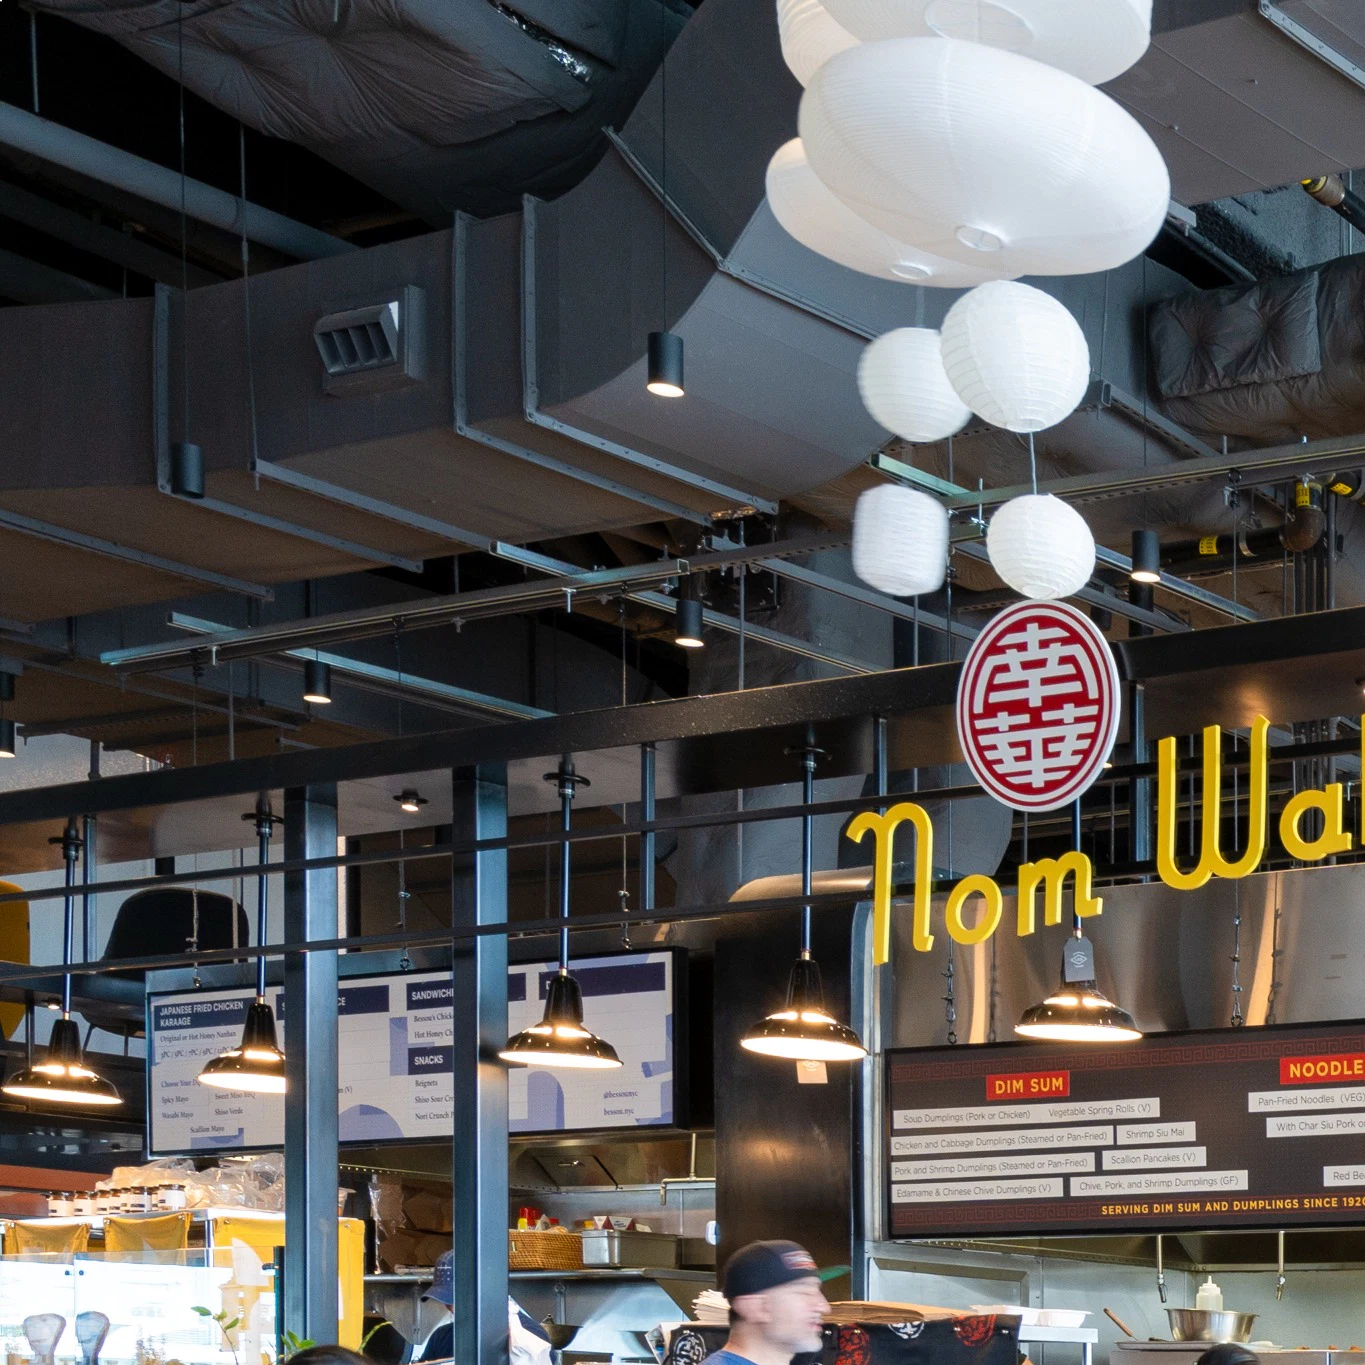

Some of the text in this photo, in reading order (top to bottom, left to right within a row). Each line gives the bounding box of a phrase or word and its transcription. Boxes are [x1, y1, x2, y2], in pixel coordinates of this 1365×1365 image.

[846, 802, 1103, 966] Nom
[160, 1001, 243, 1015] JAPANESE FRIED CHICKEN
[160, 1017, 191, 1026] KARAAGE
[415, 1055, 443, 1065] SNACKS
[995, 1077, 1063, 1094] DIM SUM
[1258, 1093, 1365, 1106] Pan-Fried Noodles (VEG)
[1048, 1103, 1151, 1117] Vegetable Spring Rolls (V)
[904, 1115, 922, 1125] Soup
[925, 1113, 963, 1124] Dumplings
[966, 1112, 986, 1122] (Pork
[998, 1110, 1031, 1120] Chicken)
[1277, 1122, 1296, 1131] With
[1299, 1122, 1317, 1130] Char
[1321, 1121, 1333, 1129] Siu
[1337, 1120, 1355, 1128] Pork
[894, 1141, 922, 1150] Chicken
[925, 1140, 938, 1149] and
[941, 1138, 974, 1149] Cabbage
[976, 1136, 1015, 1147] Dumplings
[1018, 1134, 1054, 1145] (Steamed
[1067, 1132, 1107, 1143] Pan-Fried)
[1126, 1128, 1184, 1140] Shrimp Siu Mai
[1111, 1152, 1196, 1164] Scallion Pancakes (V)
[894, 1167, 912, 1176] Pork
[914, 1166, 927, 1174] and
[929, 1164, 955, 1174] Shrimp
[958, 1162, 996, 1172] Dumplings
[999, 1161, 1035, 1171] (Steamed
[1048, 1158, 1087, 1169] Pan-Fried)
[1333, 1171, 1349, 1180] Red
[897, 1183, 1051, 1198] Edamame & Chinese Chive Dumplings (V)
[1080, 1176, 1238, 1192] Chive, Pork, and Shrimp Dumplings (GF)
[1102, 1204, 1148, 1215] SERVING
[1153, 1203, 1173, 1213] DIM
[1178, 1202, 1200, 1212] SUM
[1205, 1201, 1229, 1211] AND
[1233, 1199, 1299, 1210] DUMPLINGS
[1304, 1197, 1339, 1209] SINCE
